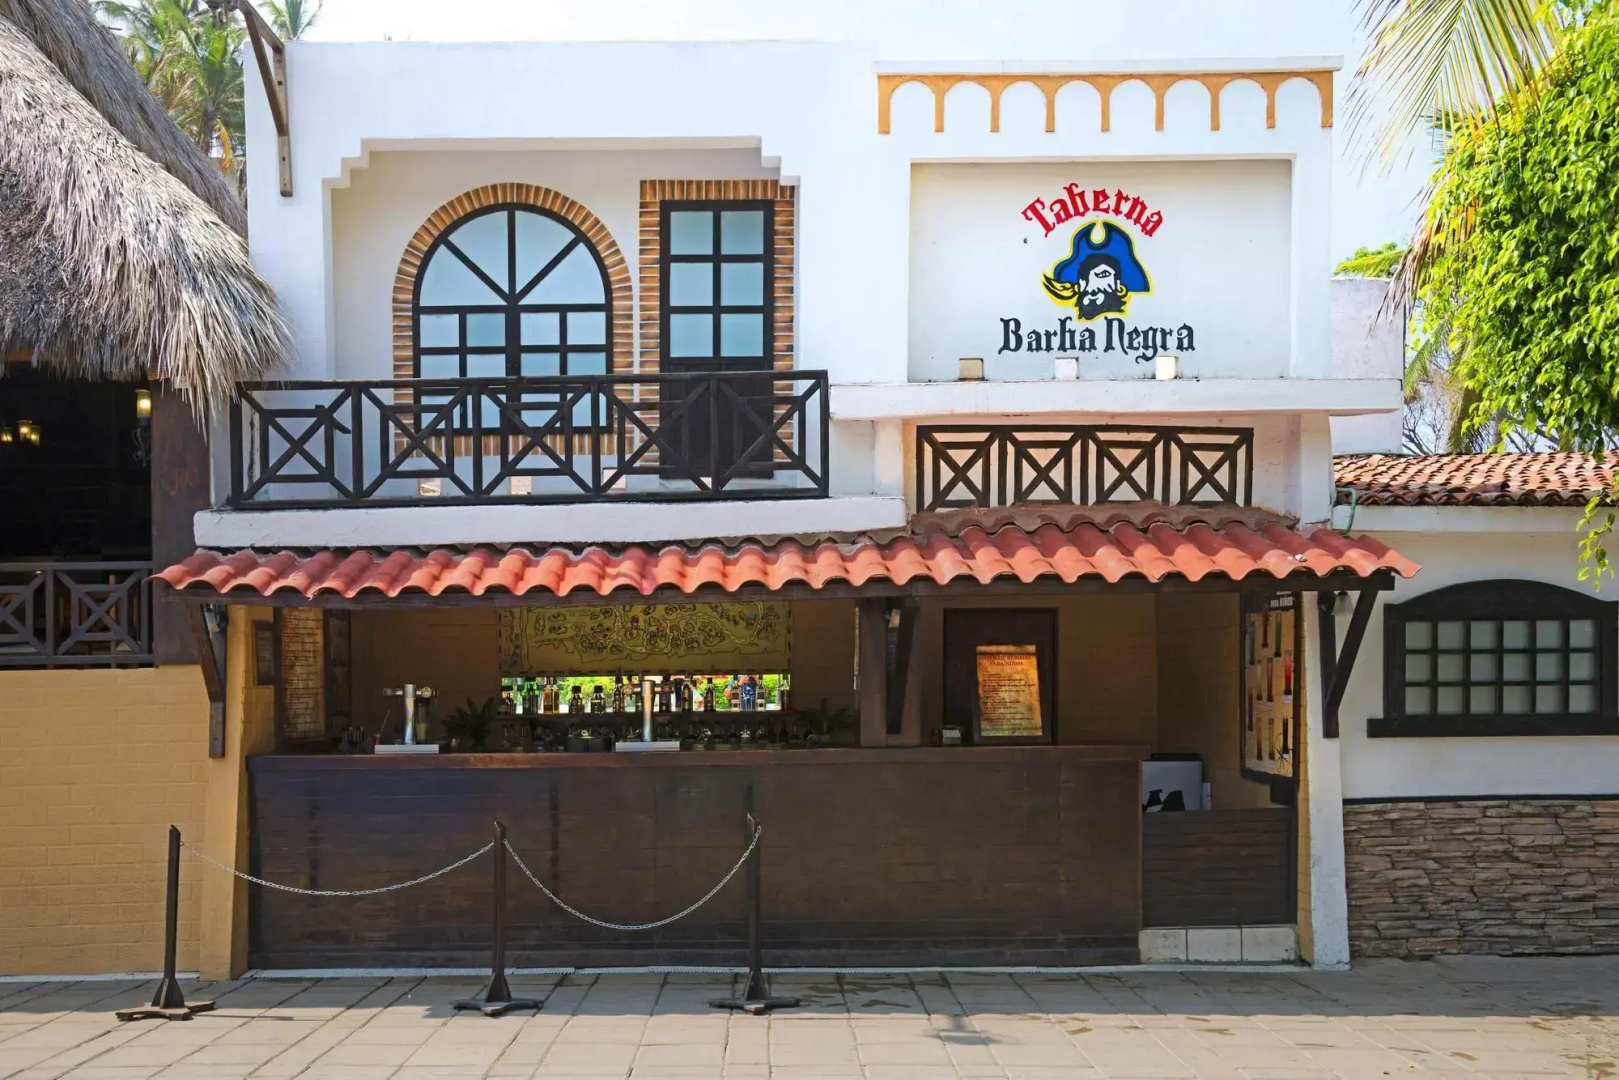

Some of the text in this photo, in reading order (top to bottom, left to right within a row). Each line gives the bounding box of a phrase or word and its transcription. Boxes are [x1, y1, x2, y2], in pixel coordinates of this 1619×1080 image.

[1021, 182, 1164, 237] Taberna
[998, 316, 1196, 364] Barba Negra
